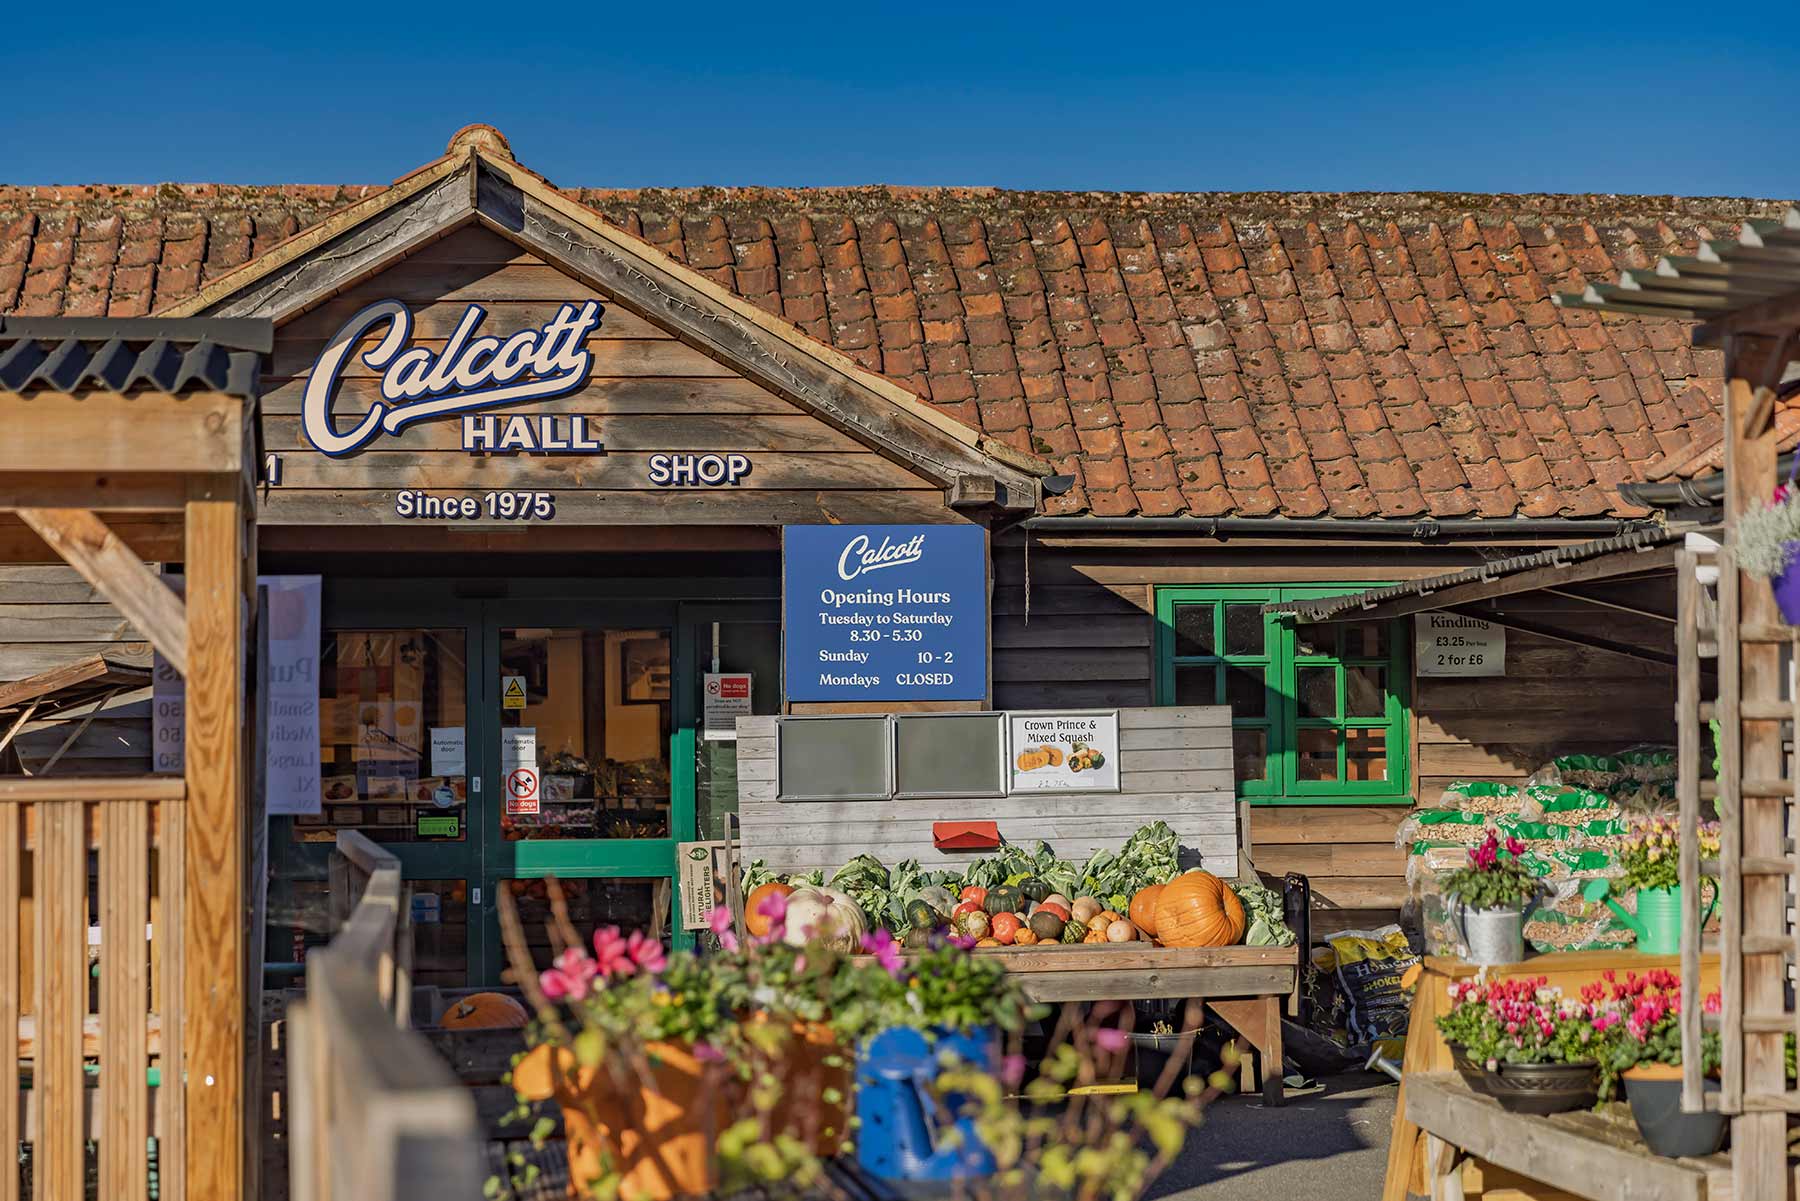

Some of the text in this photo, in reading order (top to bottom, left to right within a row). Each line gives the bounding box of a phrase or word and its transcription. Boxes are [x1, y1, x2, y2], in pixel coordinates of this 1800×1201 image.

[303, 300, 600, 454] Calcott
[462, 415, 600, 451] HALL
[649, 455, 748, 485] SHOP
[396, 490, 552, 517] Since 1975
[838, 534, 925, 581] Calcott
[821, 589, 951, 608] Opening Hours
[819, 612, 953, 627] Tuesday to Saturday
[1430, 616, 1490, 630] Kindling
[850, 630, 881, 641] 8.30
[892, 630, 922, 641] 5.30
[1436, 636, 1464, 646] £3.25
[819, 650, 869, 664] Sunday
[917, 652, 933, 663] 10
[944, 652, 953, 663] 2
[1437, 654, 1483, 665] 2 for £6
[819, 673, 953, 688] Mondays CLOSED
[1024, 720, 1097, 730] Crown Prince &
[1027, 732, 1094, 744] Mixed Squash
[703, 866, 712, 922] RELIGHTERS
[697, 886, 705, 923] NATURAL
